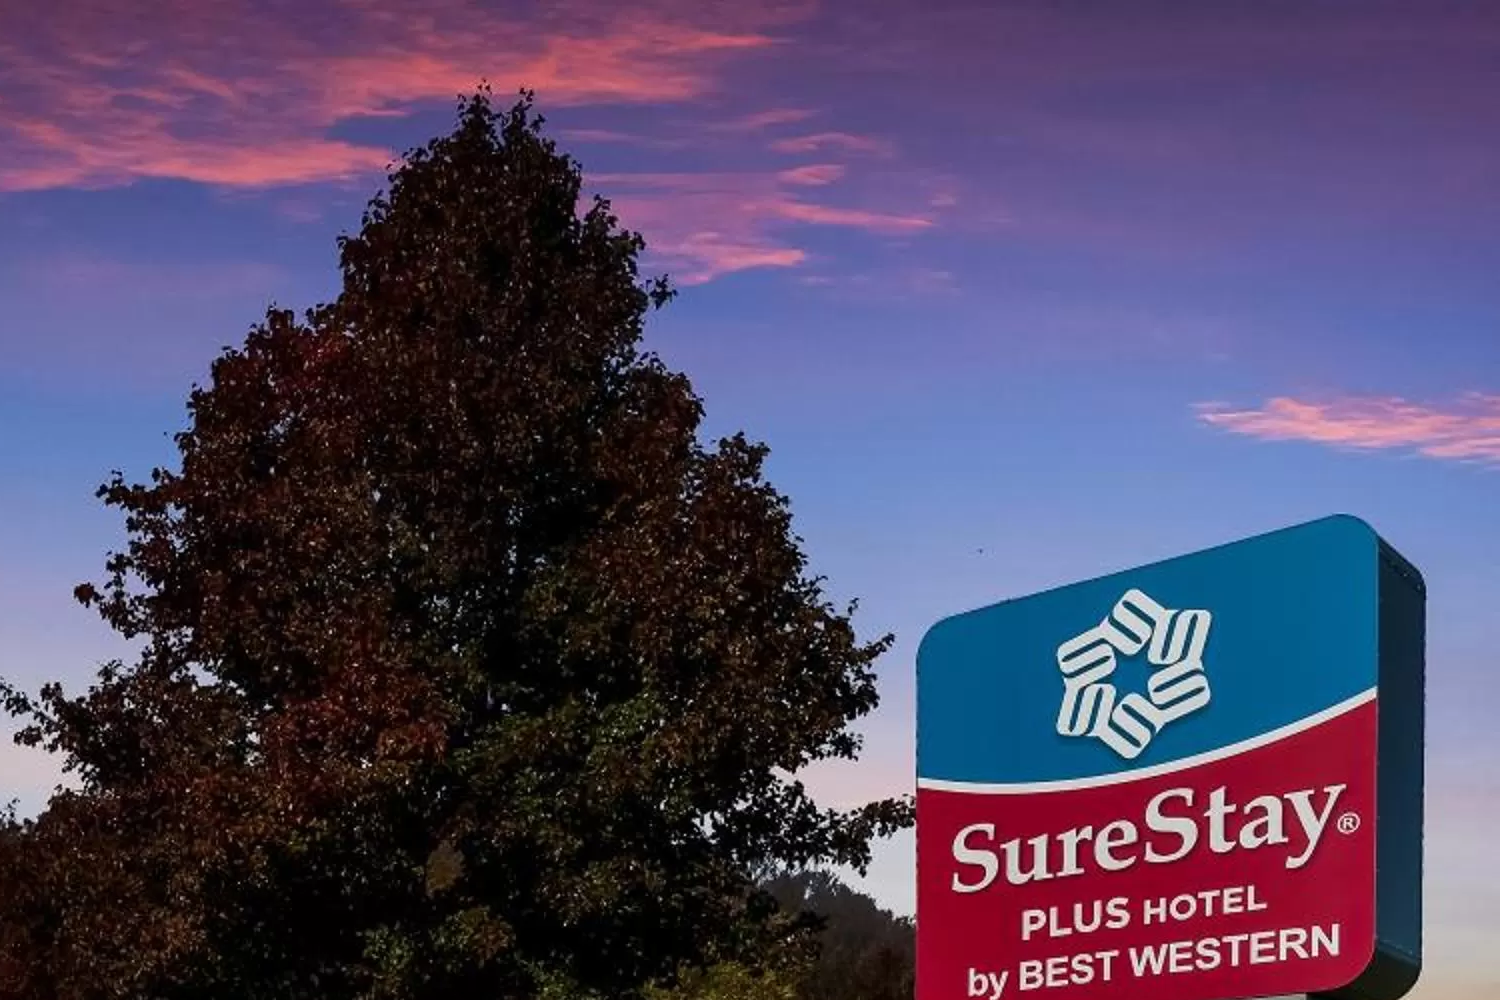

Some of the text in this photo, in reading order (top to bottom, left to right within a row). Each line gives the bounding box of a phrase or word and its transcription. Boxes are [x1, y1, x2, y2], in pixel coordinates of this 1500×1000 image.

[1021, 885, 1268, 941] PLUS HOTEL
[1018, 949, 1120, 991] BEST
[1128, 923, 1341, 978] WESTERN
